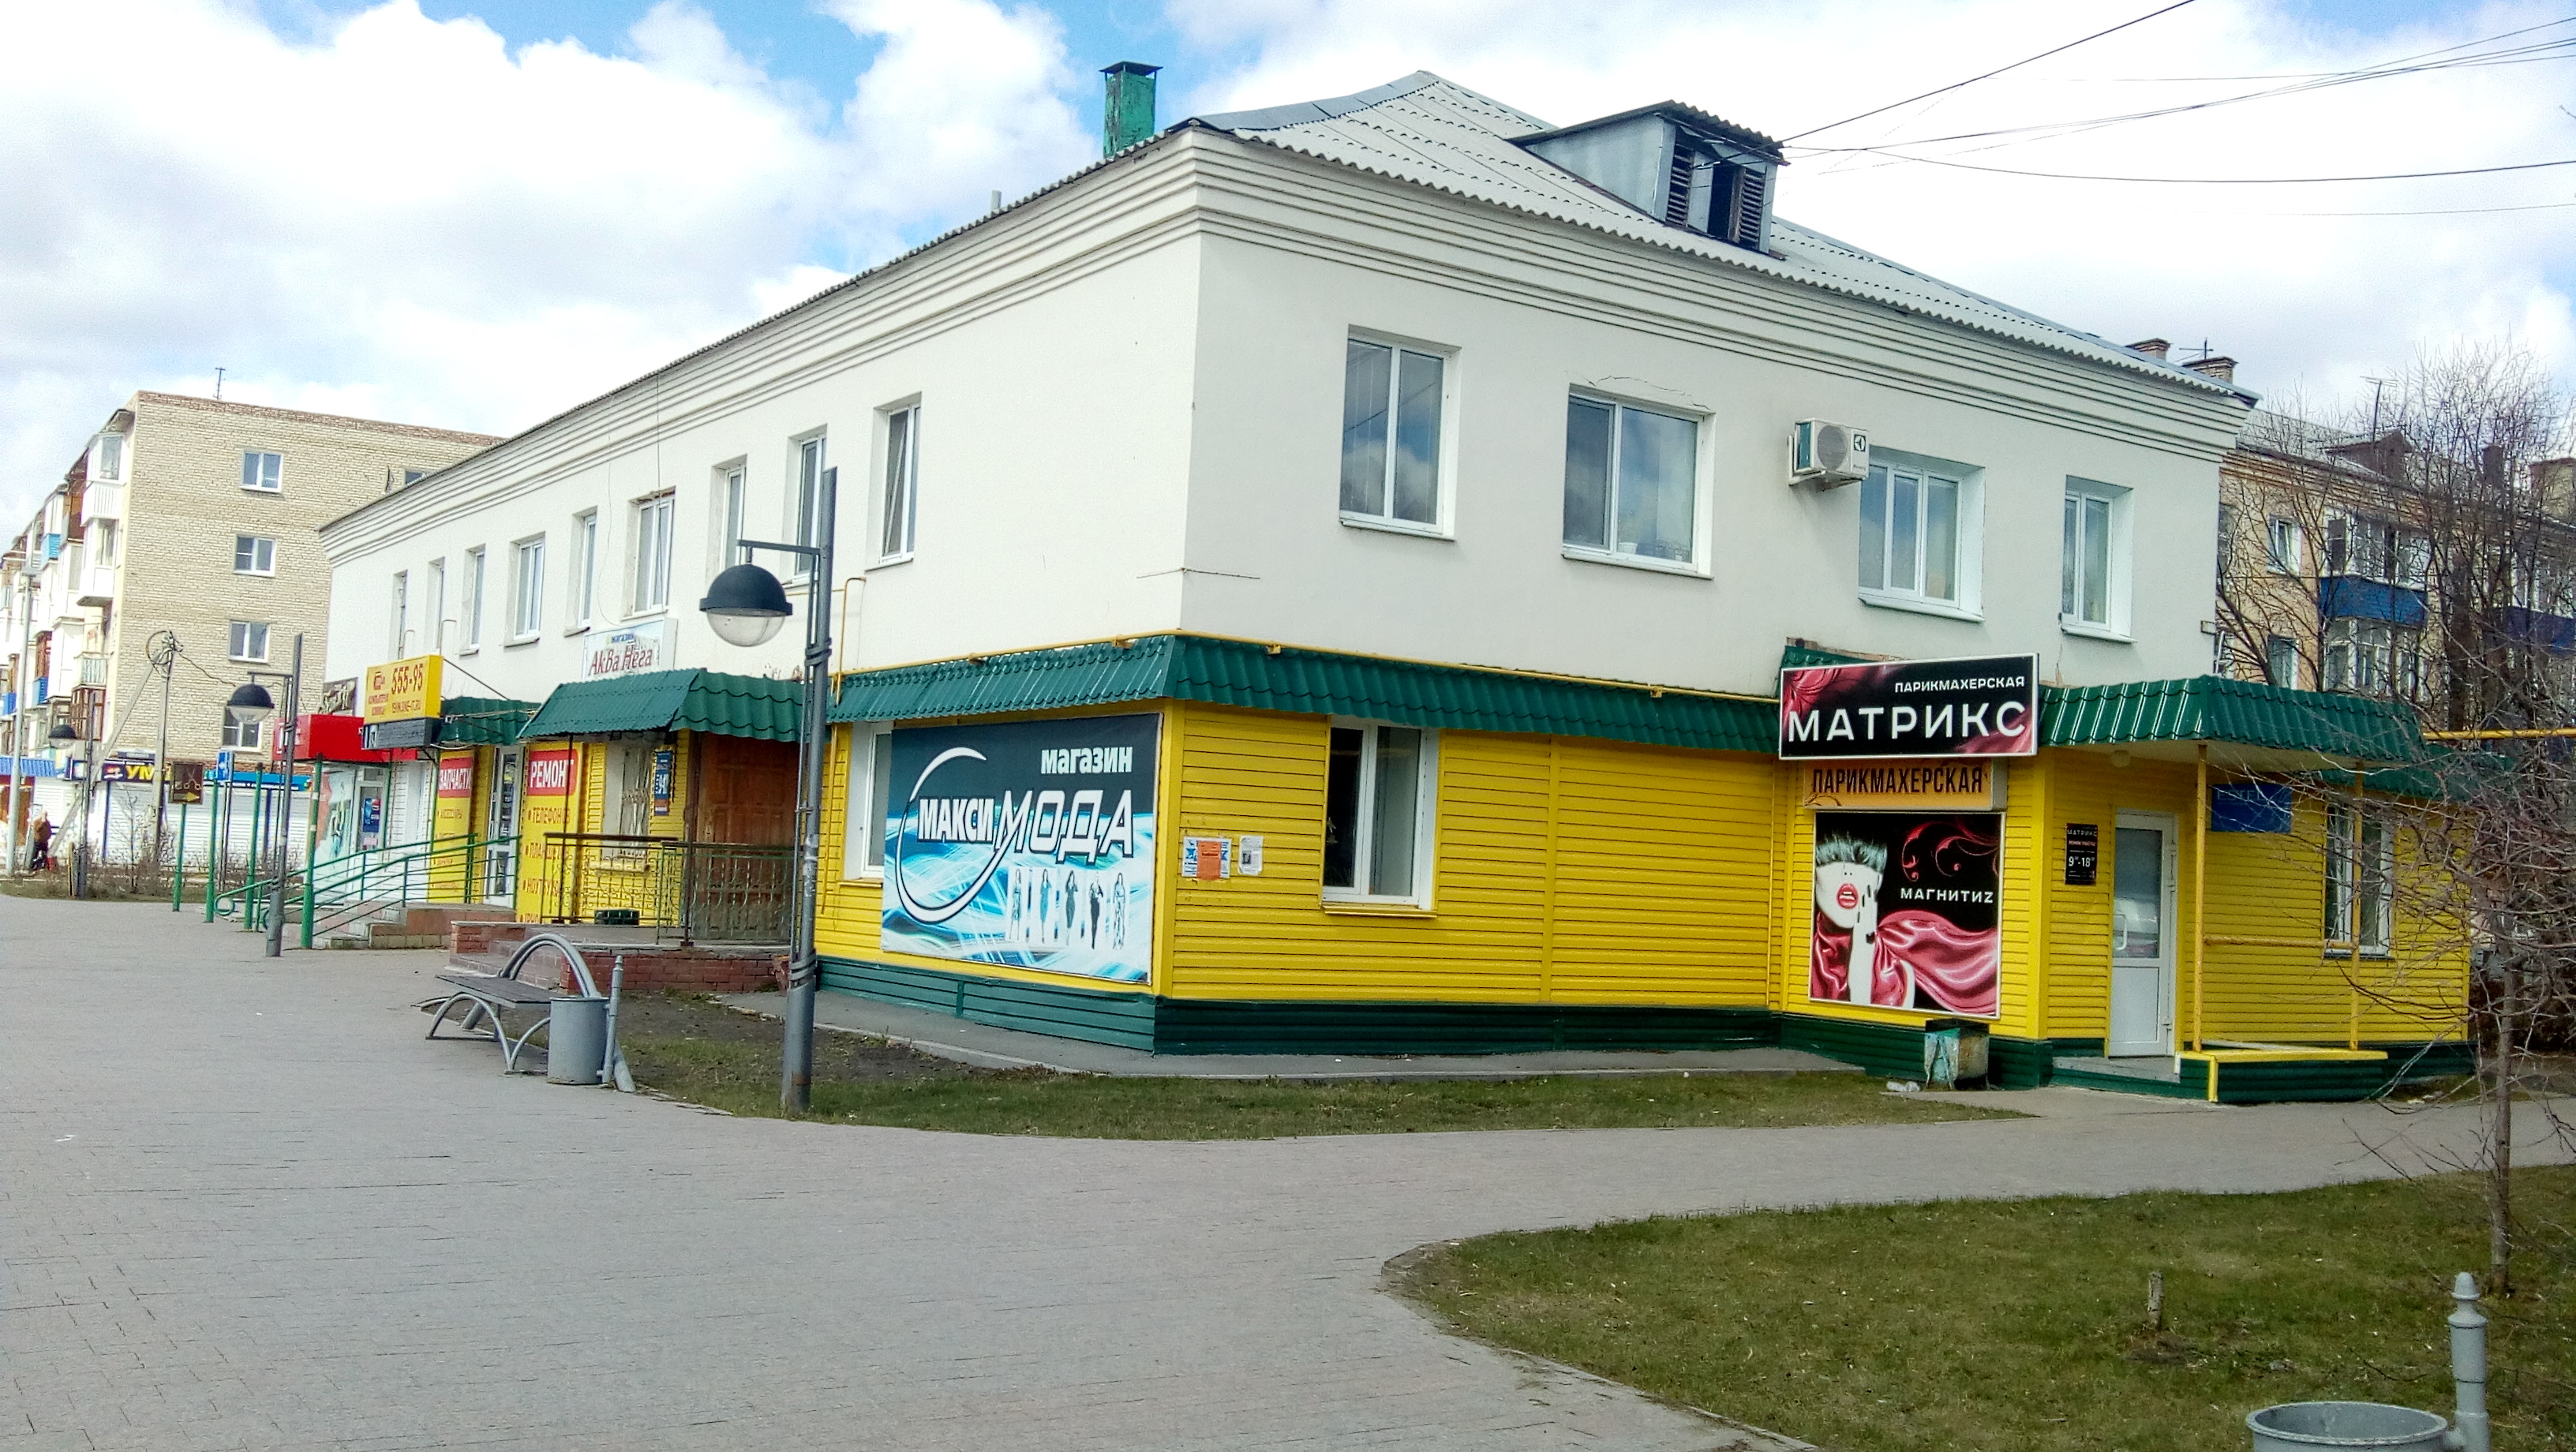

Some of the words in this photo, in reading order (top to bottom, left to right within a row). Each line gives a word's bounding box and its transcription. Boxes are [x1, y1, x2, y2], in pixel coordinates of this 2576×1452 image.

[391, 663, 424, 694] 555-95
[1895, 676, 2025, 694] ПАРИКМАХЕРСКАЯ
[1788, 701, 2026, 743] МАТРИКС
[530, 758, 575, 788] РЕМОНТ
[1041, 747, 1133, 775] магазин
[438, 768, 472, 790] ЗАПЧАСТИ
[1812, 766, 1983, 794] ПАРИКМАХЕРСКАЯ
[917, 797, 994, 842] МАКСИ
[993, 789, 1134, 865] МОДА
[2066, 829, 2098, 837] МАТРИКС
[1900, 887, 1994, 904] МАГНИТИZ
